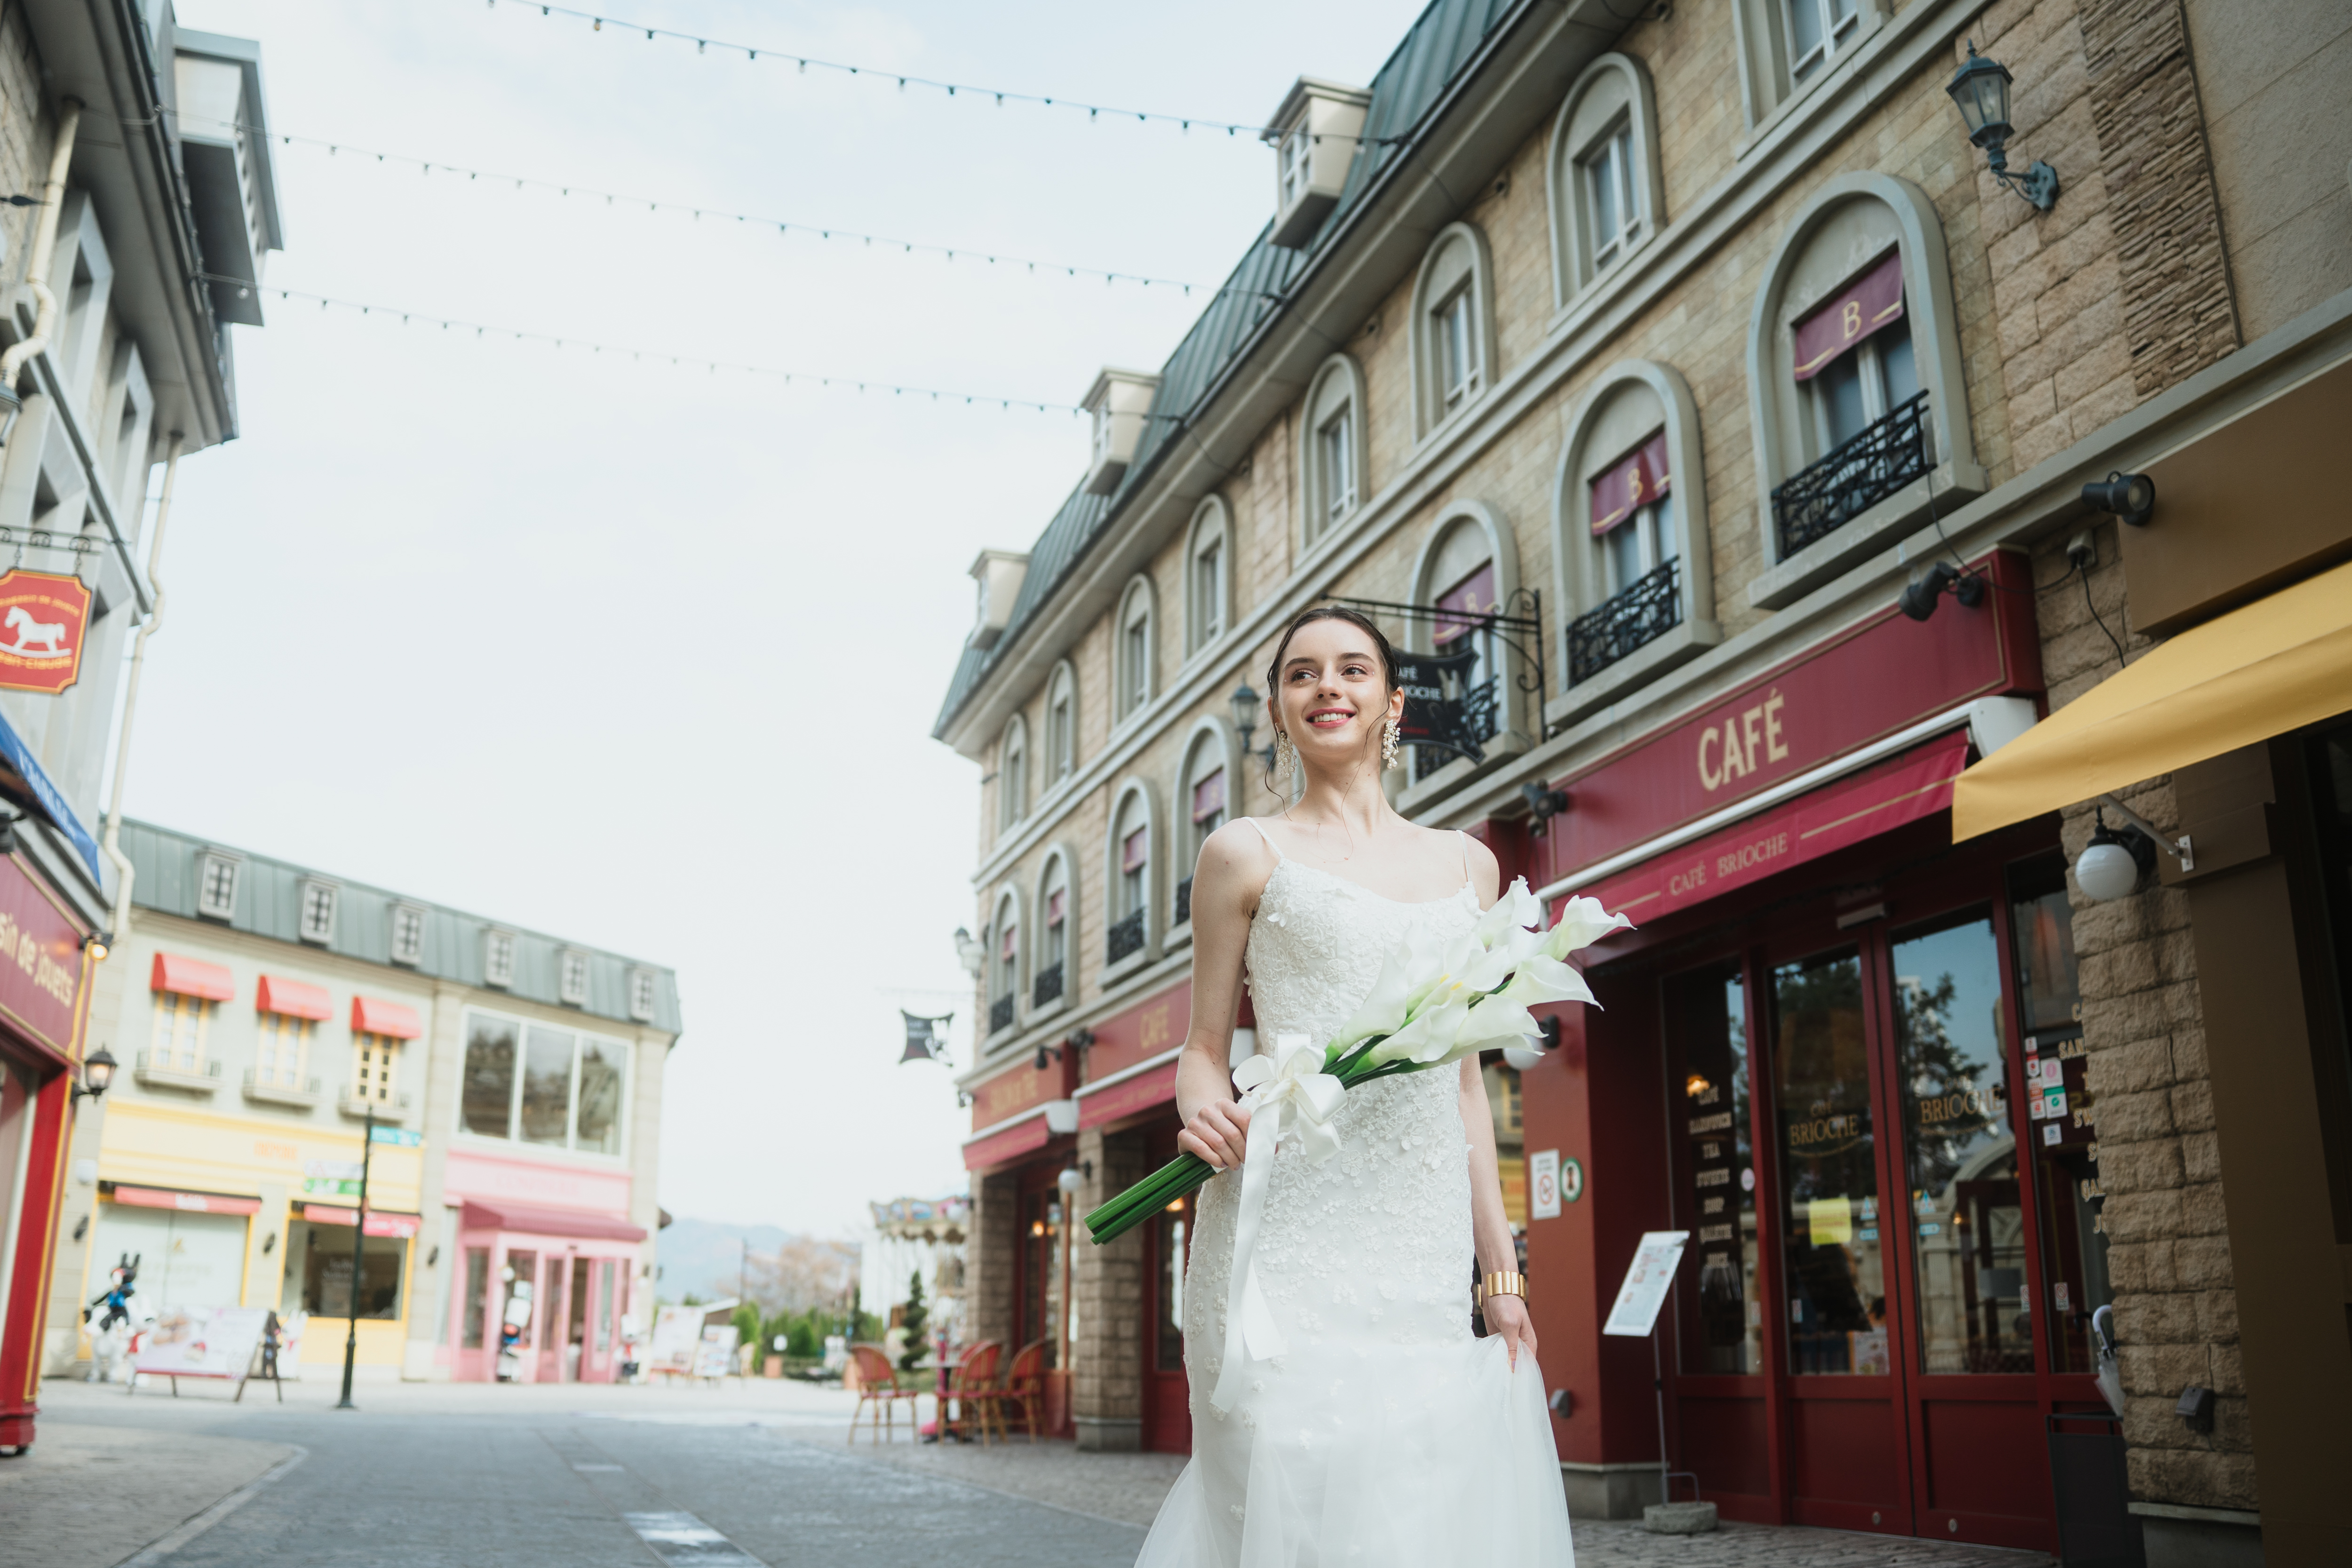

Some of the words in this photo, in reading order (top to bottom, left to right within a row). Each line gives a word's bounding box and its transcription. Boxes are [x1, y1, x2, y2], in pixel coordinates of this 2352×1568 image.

[1843, 301, 1862, 340] B
[1628, 469, 1643, 502] B
[1698, 687, 1788, 791] CAFÉ
[1669, 860, 1707, 897] CAFÉ
[1717, 832, 1788, 879] BRIOCHE
[17, 929, 36, 977] de
[34, 943, 74, 1009] jouets
[1921, 1087, 2004, 1124] BRIOCHE
[1789, 1114, 1859, 1146] BRIOCHE
[1702, 1142, 1721, 1159] TEA
